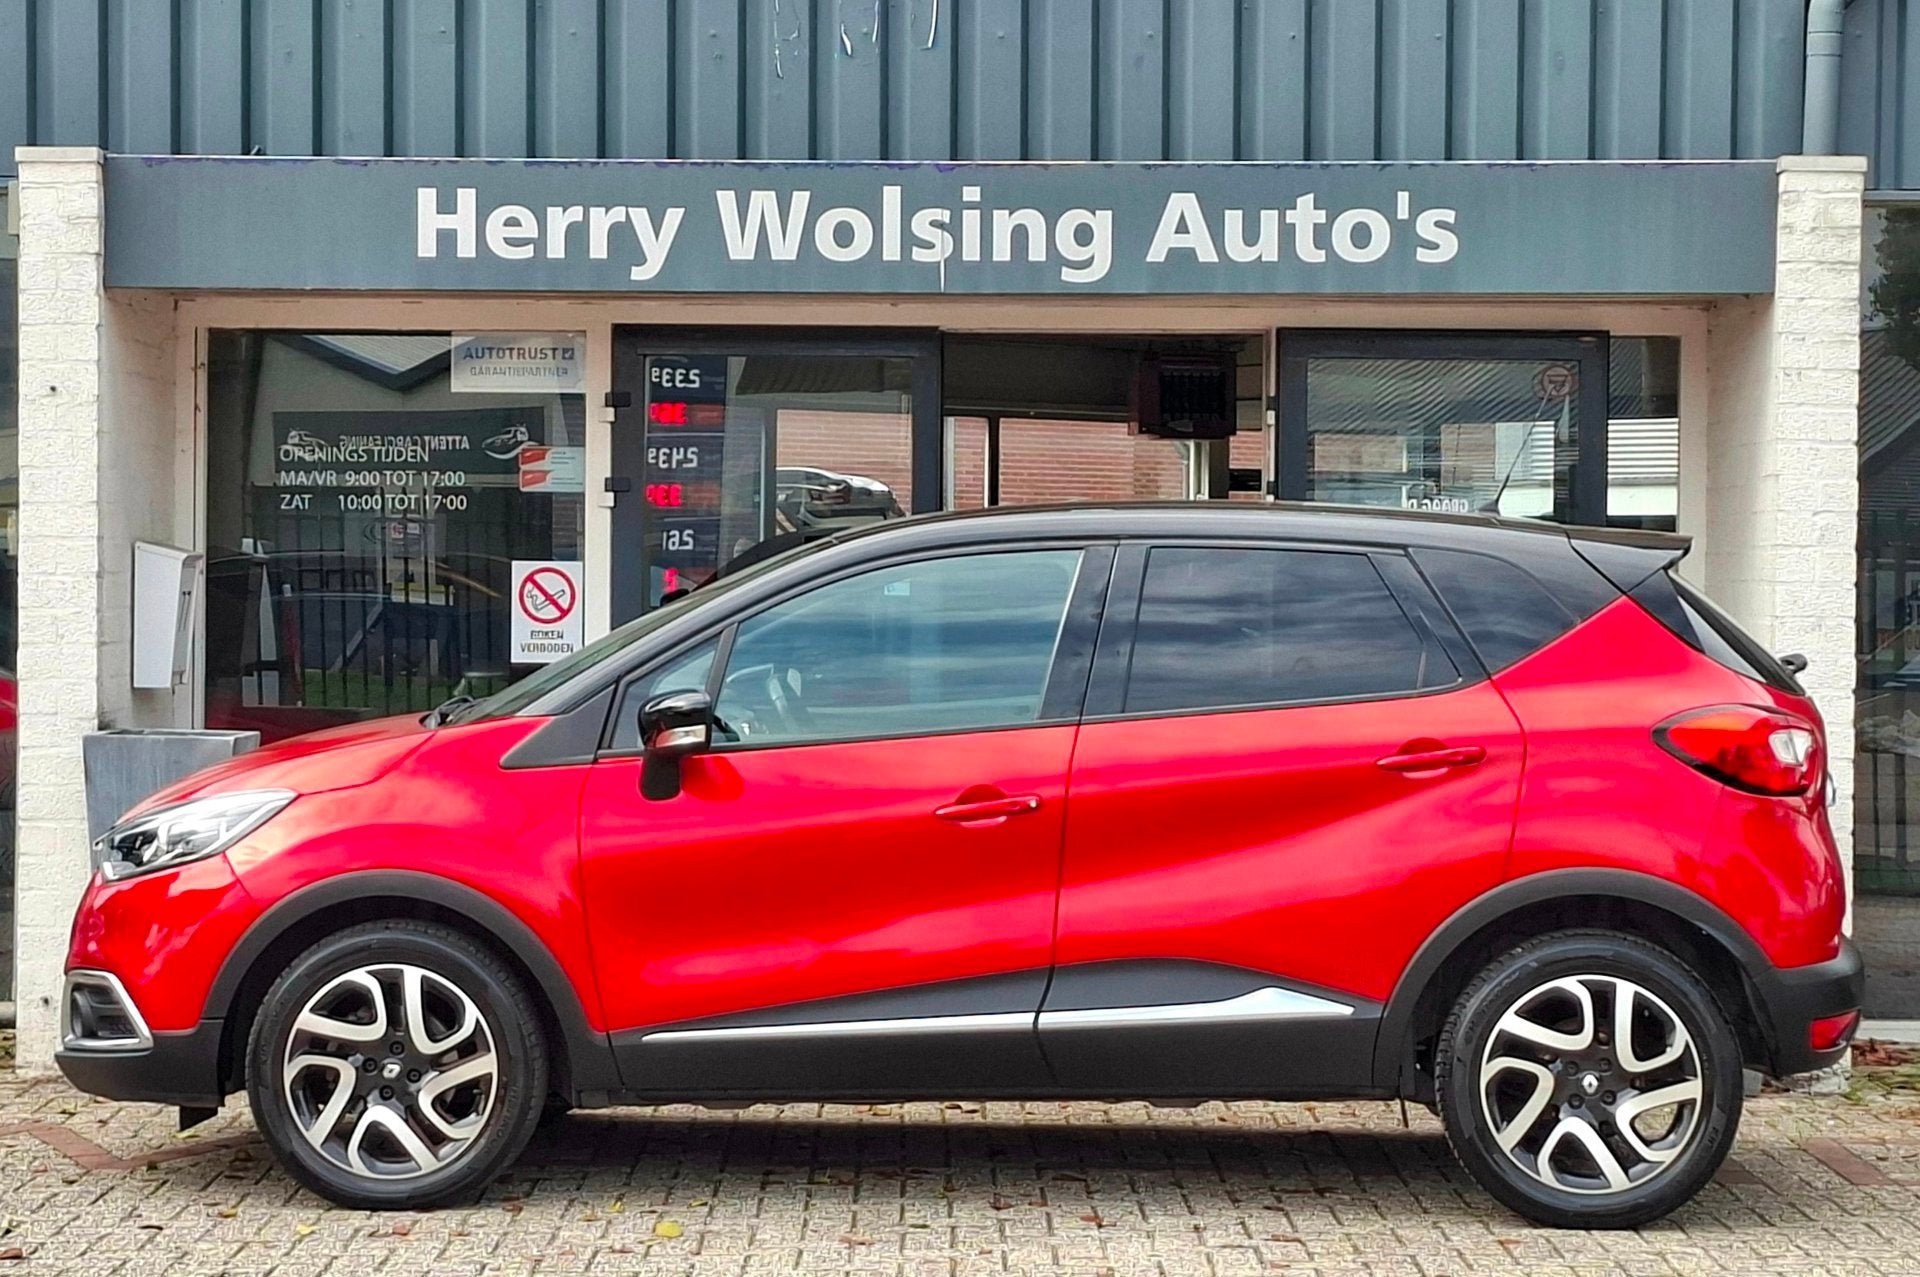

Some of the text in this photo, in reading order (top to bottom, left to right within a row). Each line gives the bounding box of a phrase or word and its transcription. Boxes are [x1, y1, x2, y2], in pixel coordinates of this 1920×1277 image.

[417, 186, 1458, 283] Herry Wolsing Auto's
[463, 347, 559, 360] AUTOTRUST
[279, 446, 430, 462] OPENINGS TIJDEN
[280, 470, 465, 486] MA/VR 9:00 TOT 17:00
[280, 494, 468, 510] ZAT 10:00 TOT 17:00
